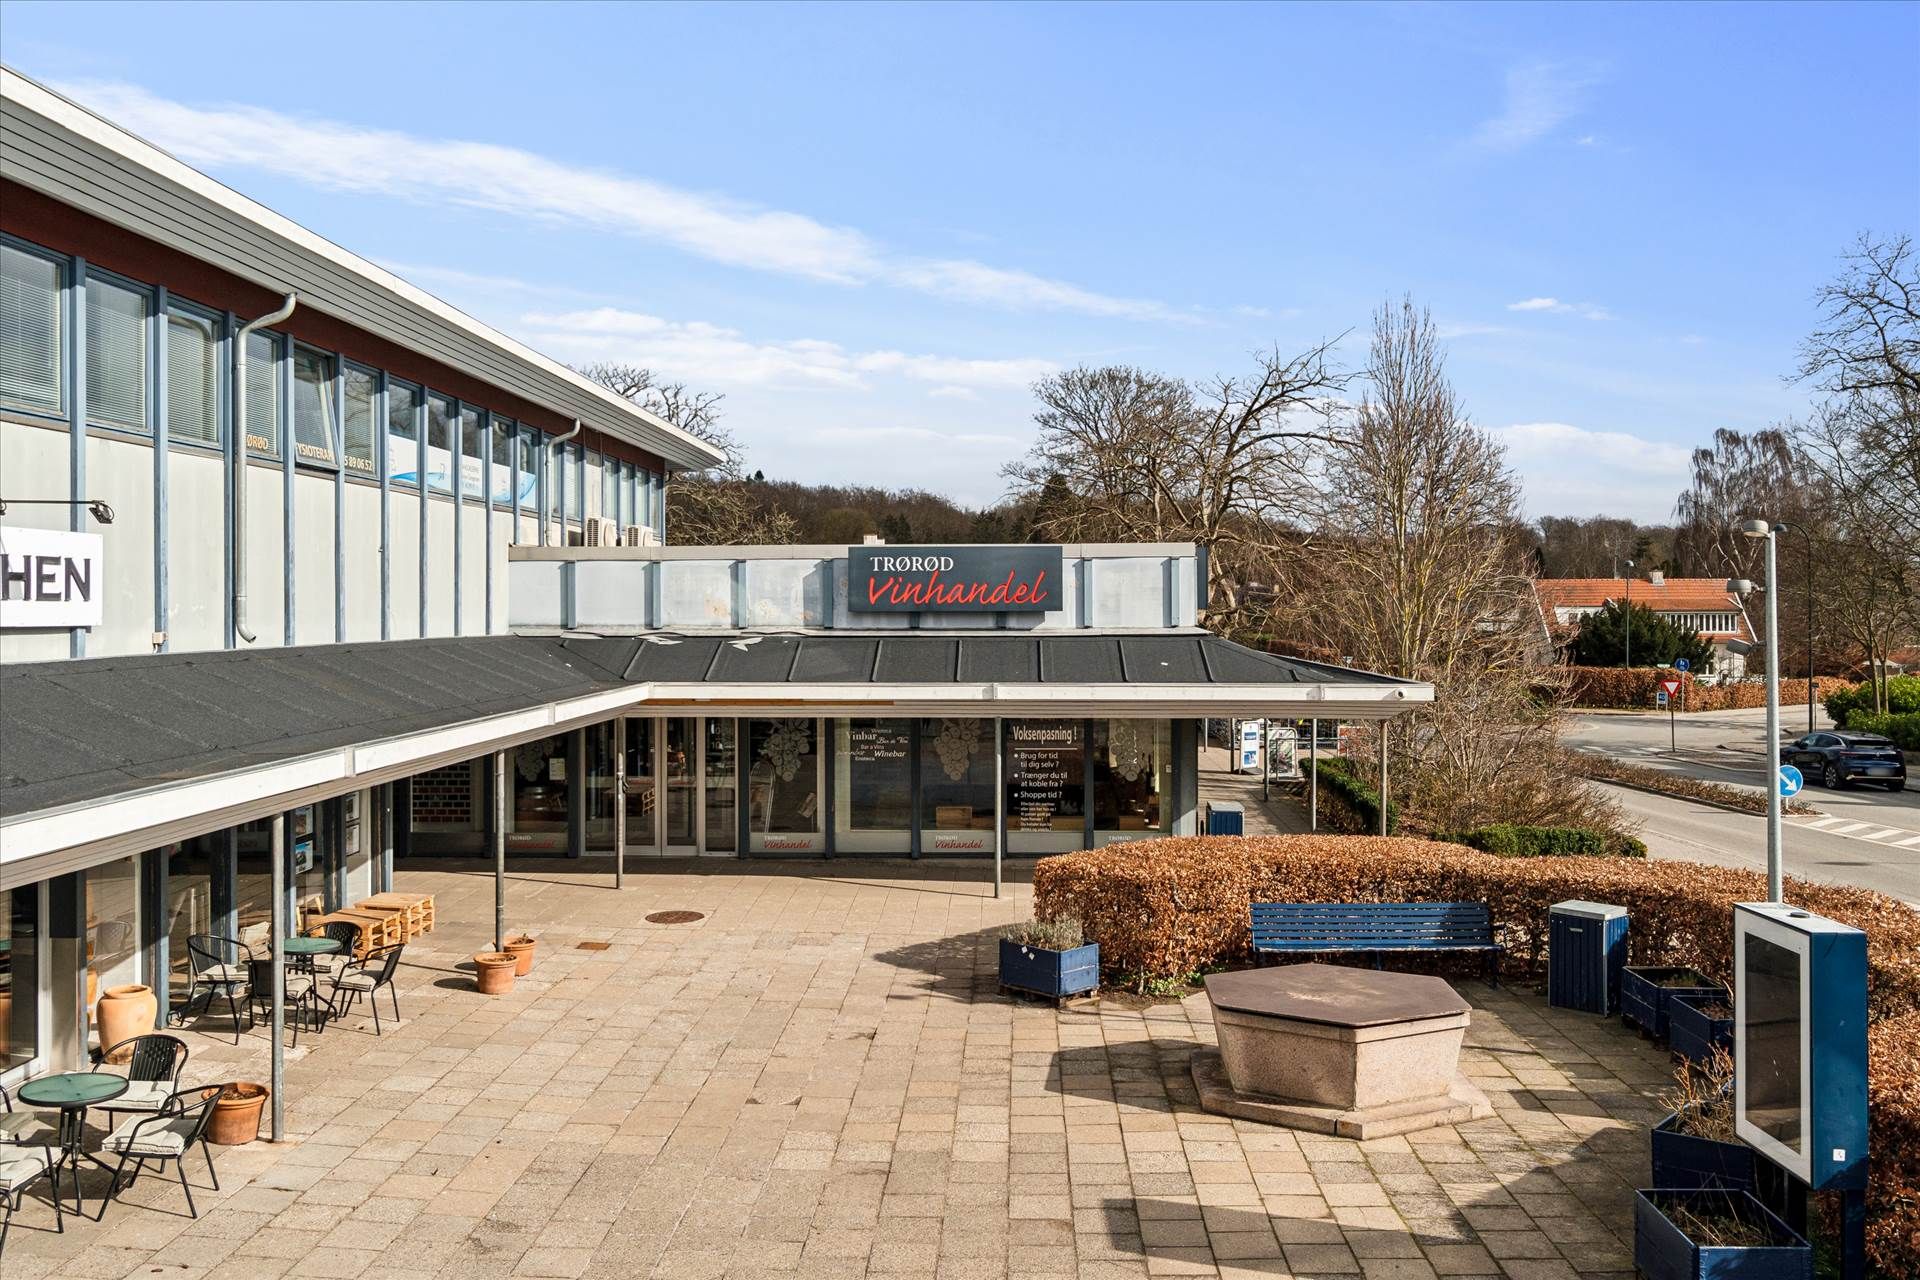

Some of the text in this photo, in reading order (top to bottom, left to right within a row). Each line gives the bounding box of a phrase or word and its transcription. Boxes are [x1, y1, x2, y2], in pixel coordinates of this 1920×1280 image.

[870, 556, 954, 572] TRØRØD
[868, 569, 1048, 606] Vinhandel
[1013, 725, 1072, 745] Voksenpasning
[874, 749, 906, 758] Winebar
[1020, 752, 1037, 761] Brug
[1020, 760, 1028, 768] til
[1028, 760, 1040, 770] dig
[1041, 760, 1055, 768] selv
[1020, 771, 1068, 780] Trænger du til
[1028, 780, 1048, 788] koble
[1020, 791, 1047, 799] Shoppe
[1047, 791, 1058, 799] tid
